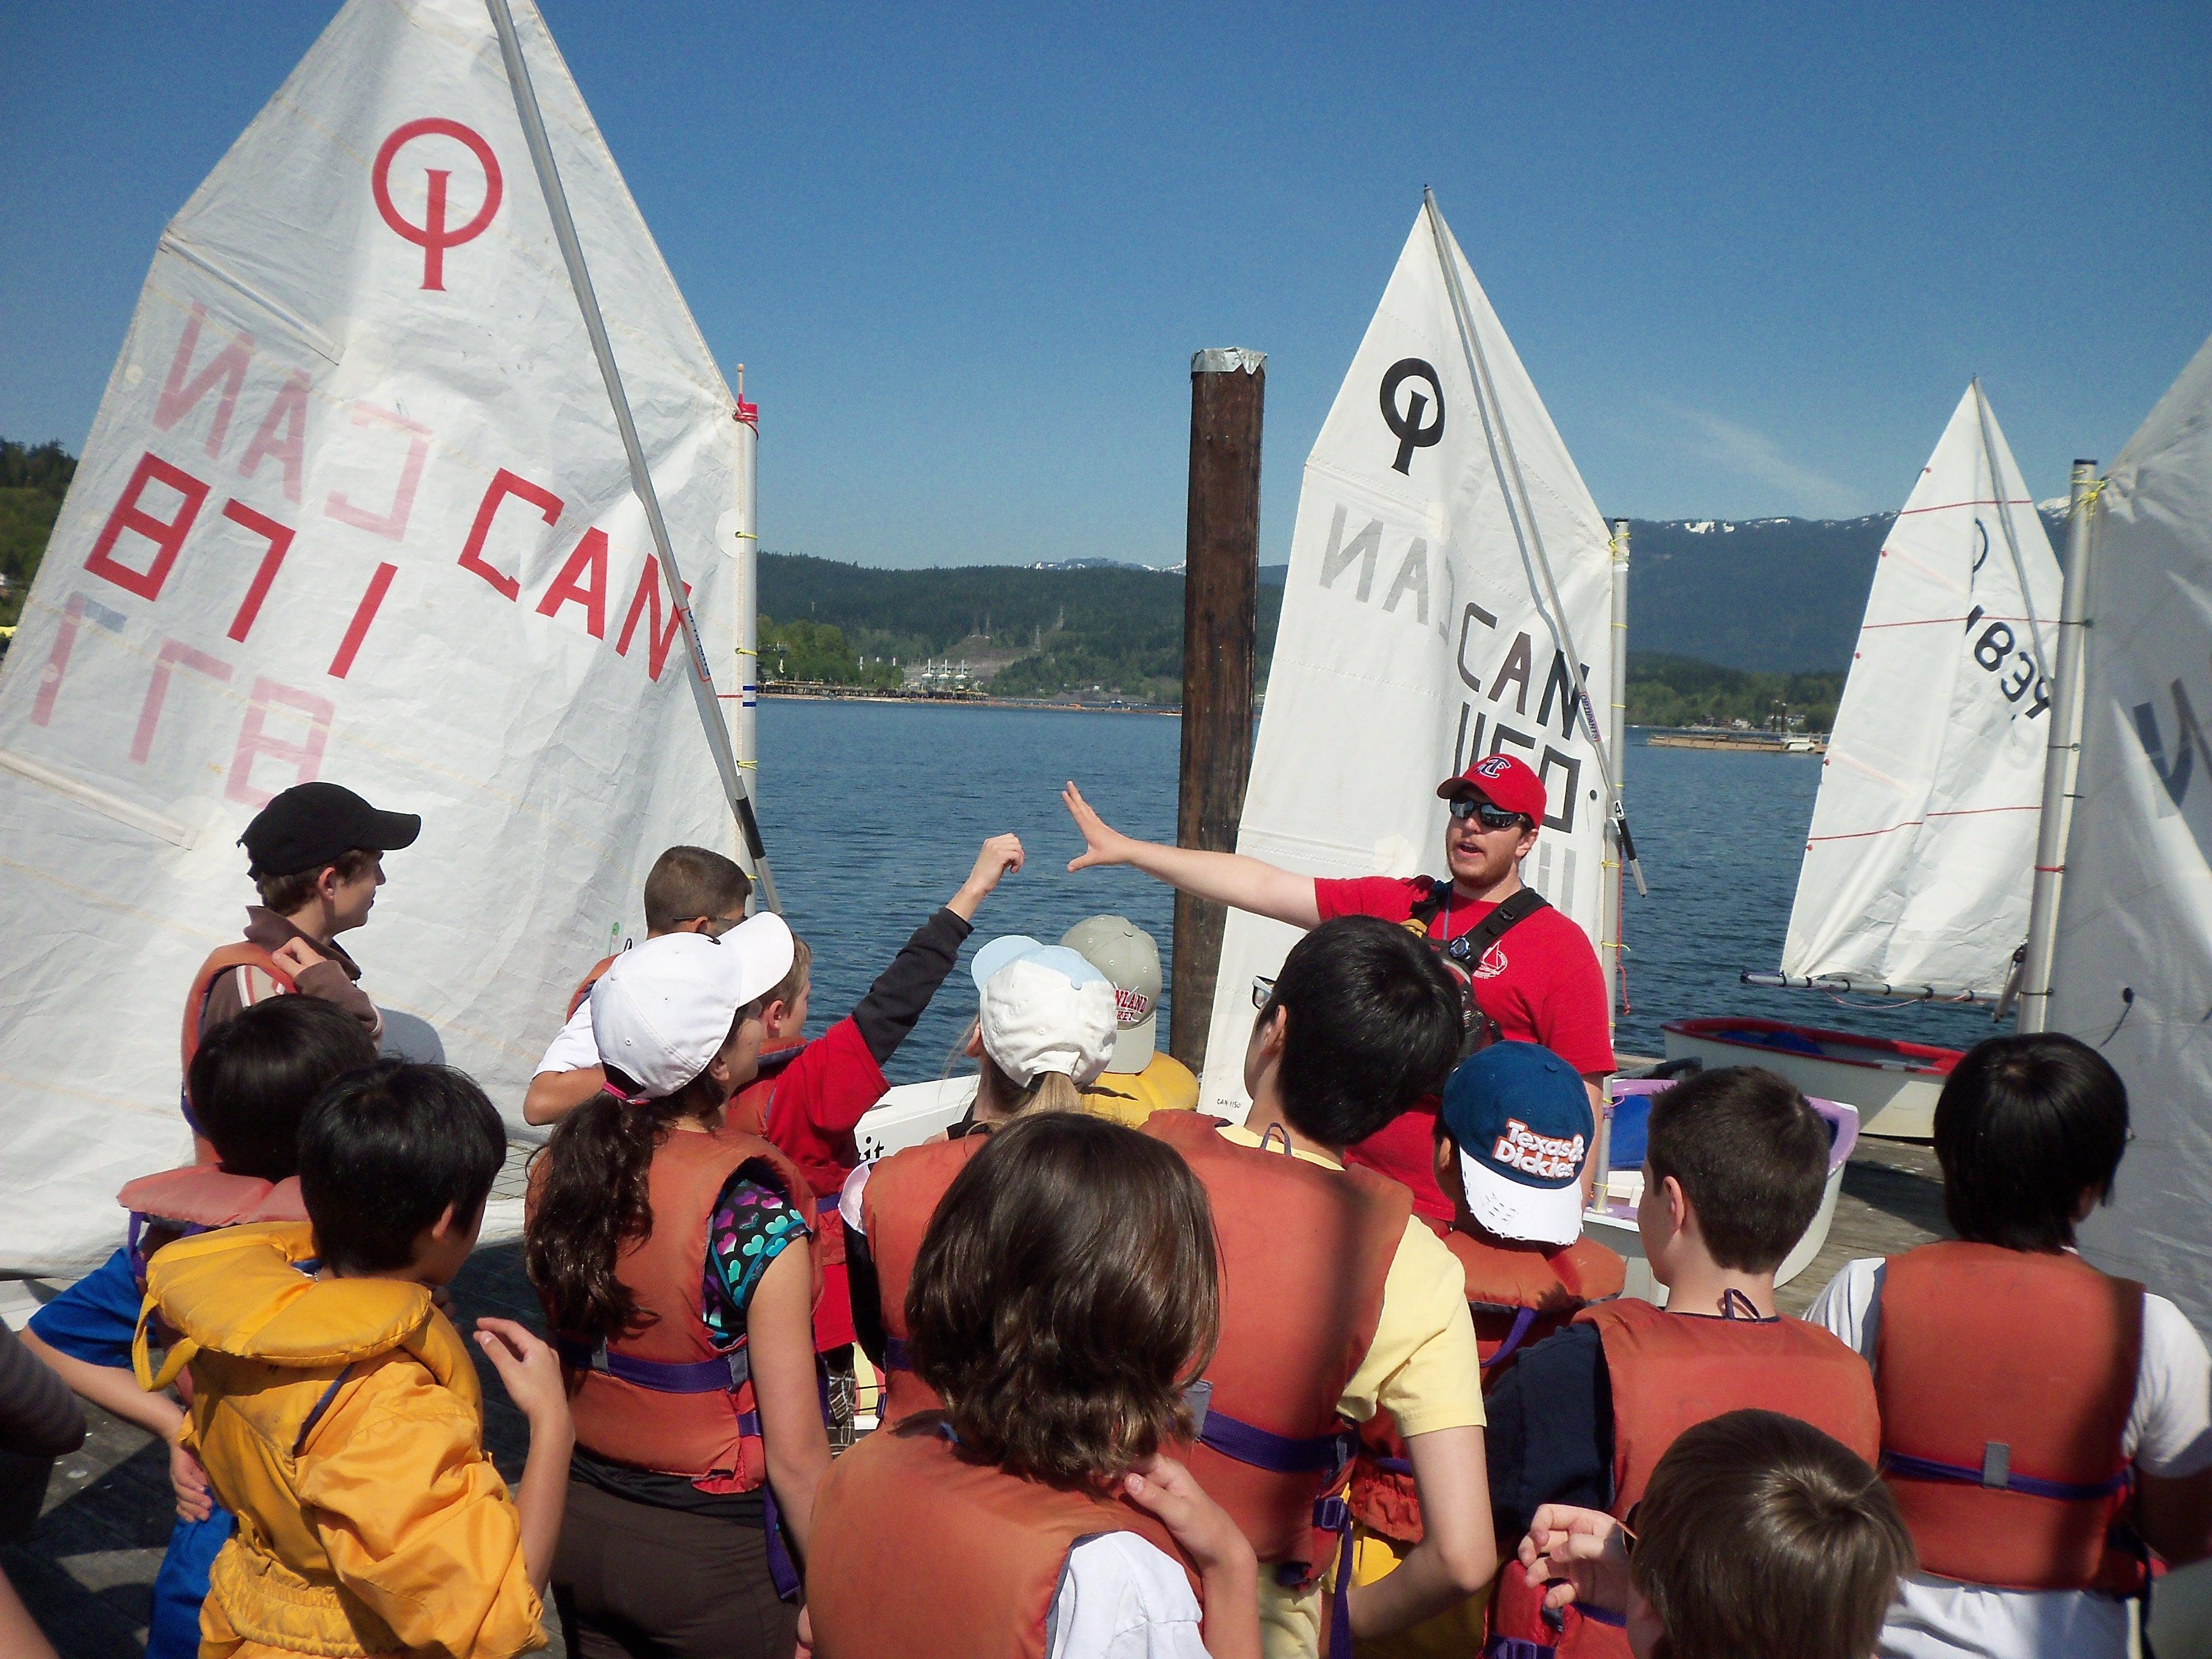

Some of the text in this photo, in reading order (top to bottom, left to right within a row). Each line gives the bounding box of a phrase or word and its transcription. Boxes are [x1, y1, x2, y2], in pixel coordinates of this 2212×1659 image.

[83, 451, 398, 679] 871
[457, 467, 692, 683] CAN
[1457, 602, 1590, 741] CAN
[1615, 802, 1623, 816] 4
[1116, 1009, 1134, 1022] KEY
[1493, 1138, 1575, 1178] Dickies
